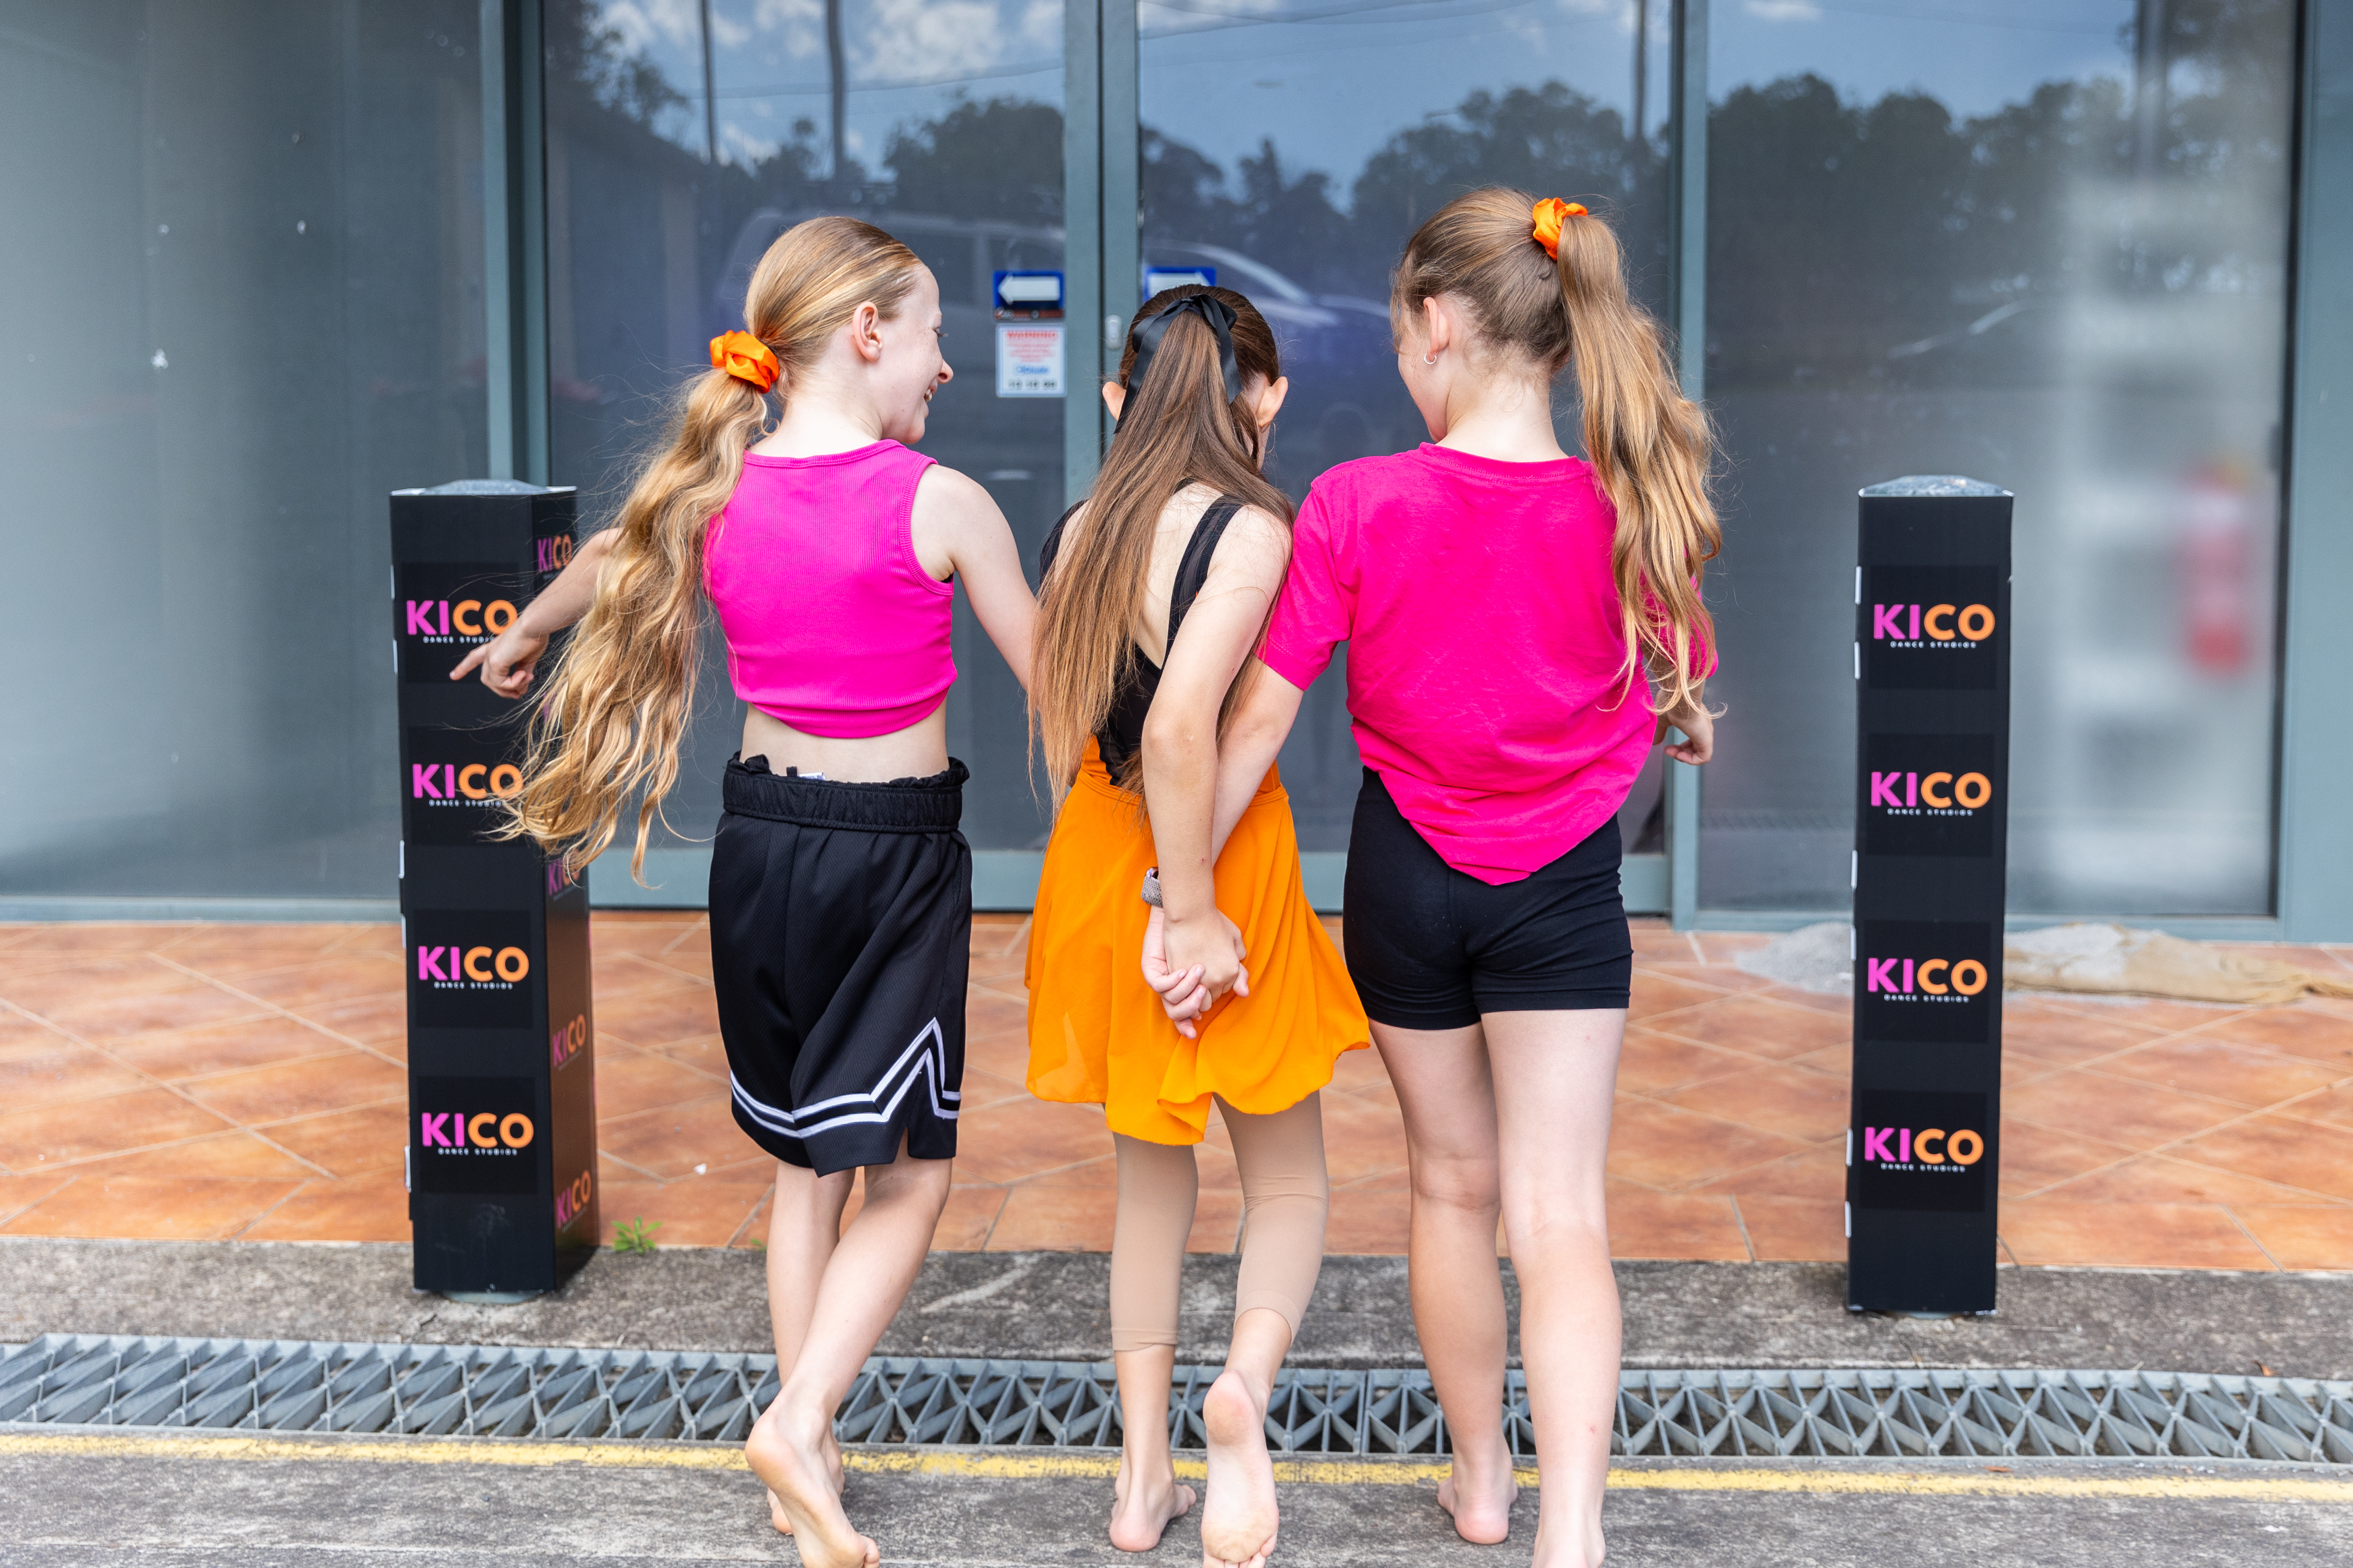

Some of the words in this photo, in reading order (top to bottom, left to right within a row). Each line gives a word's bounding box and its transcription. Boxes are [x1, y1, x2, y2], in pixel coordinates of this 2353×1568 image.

[537, 534, 572, 573] KICO
[407, 599, 518, 636] KICO
[1873, 604, 1995, 641] KICO
[412, 763, 524, 800] KICO
[1871, 771, 1992, 808] KICO
[465, 799, 502, 807] STUDIO
[418, 945, 529, 982] KICO
[1867, 957, 1987, 995] KICO
[553, 1013, 586, 1067] KICO
[422, 1112, 534, 1149] KICO
[1864, 1127, 1984, 1165] KICO
[557, 1170, 591, 1229] KICO
